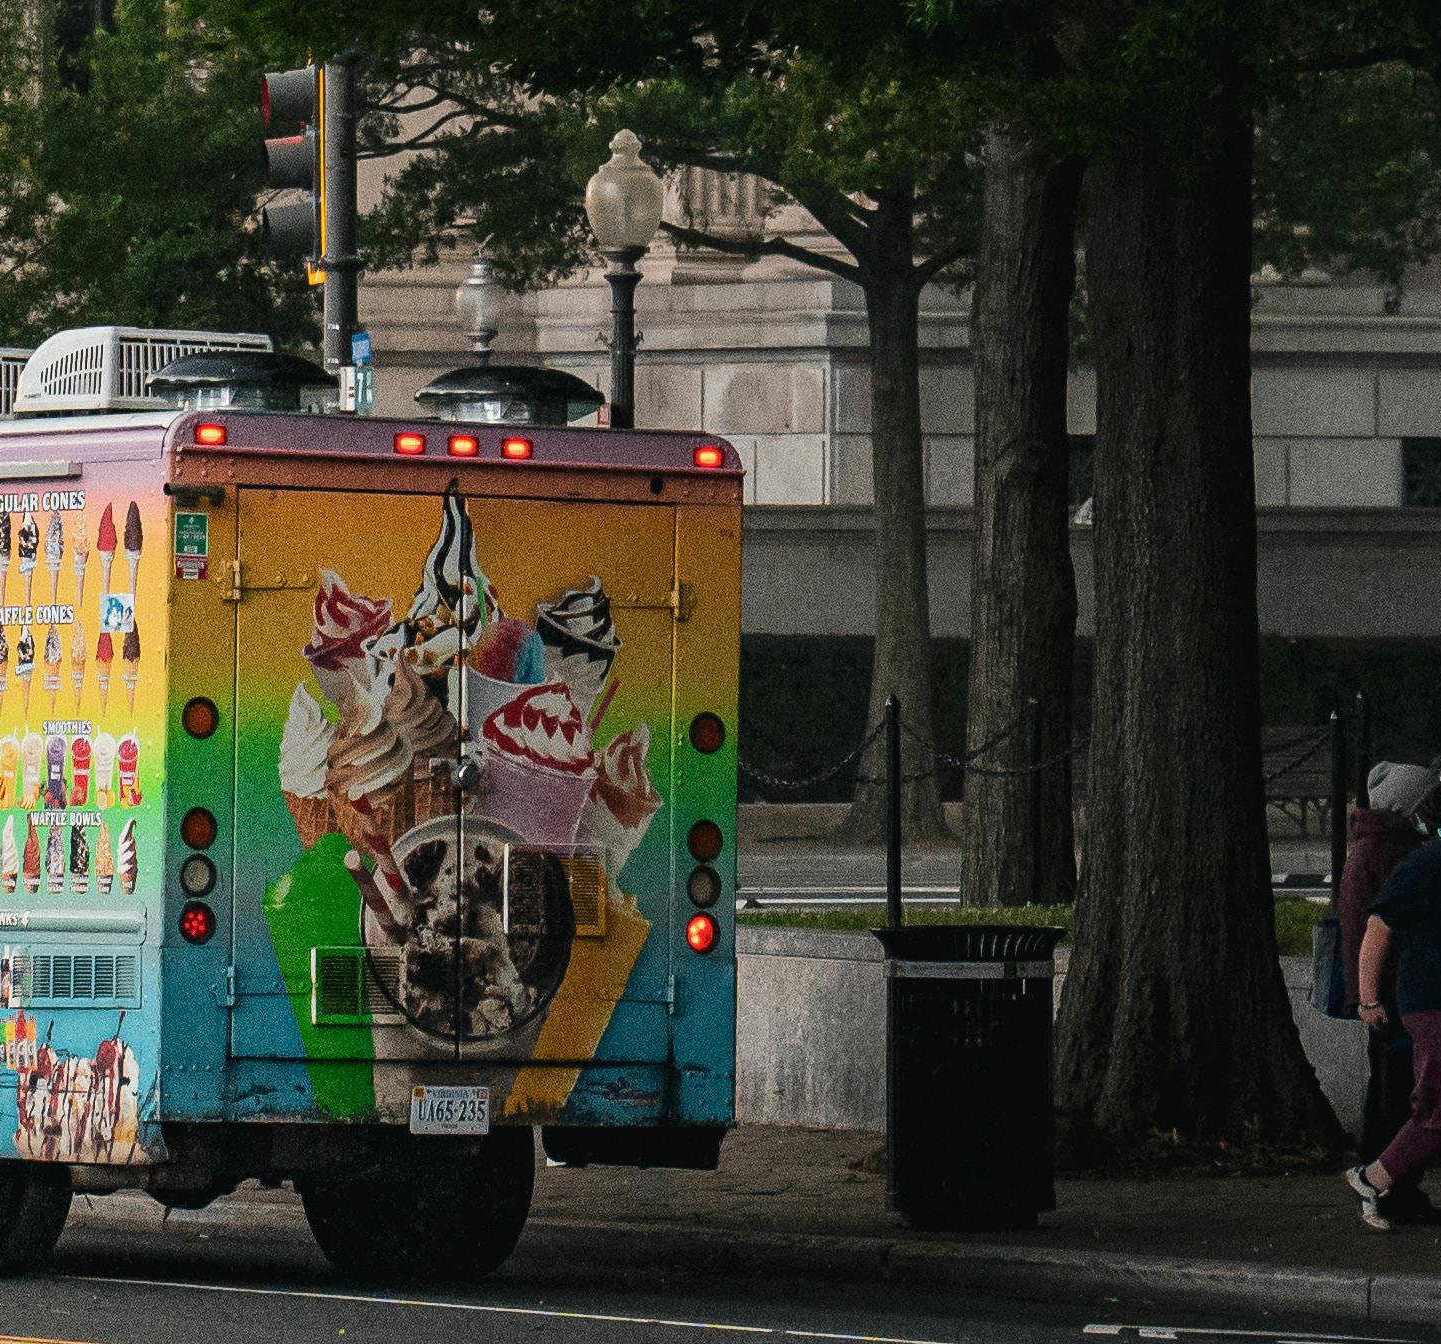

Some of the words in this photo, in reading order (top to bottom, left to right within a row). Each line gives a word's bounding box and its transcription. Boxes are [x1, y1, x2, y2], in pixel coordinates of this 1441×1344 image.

[43, 491, 86, 511] CONES
[36, 605, 74, 624] CONES
[42, 720, 92, 735] SMOOTHIES
[31, 812, 67, 826] WAFFLE
[69, 812, 103, 827] BOWLS
